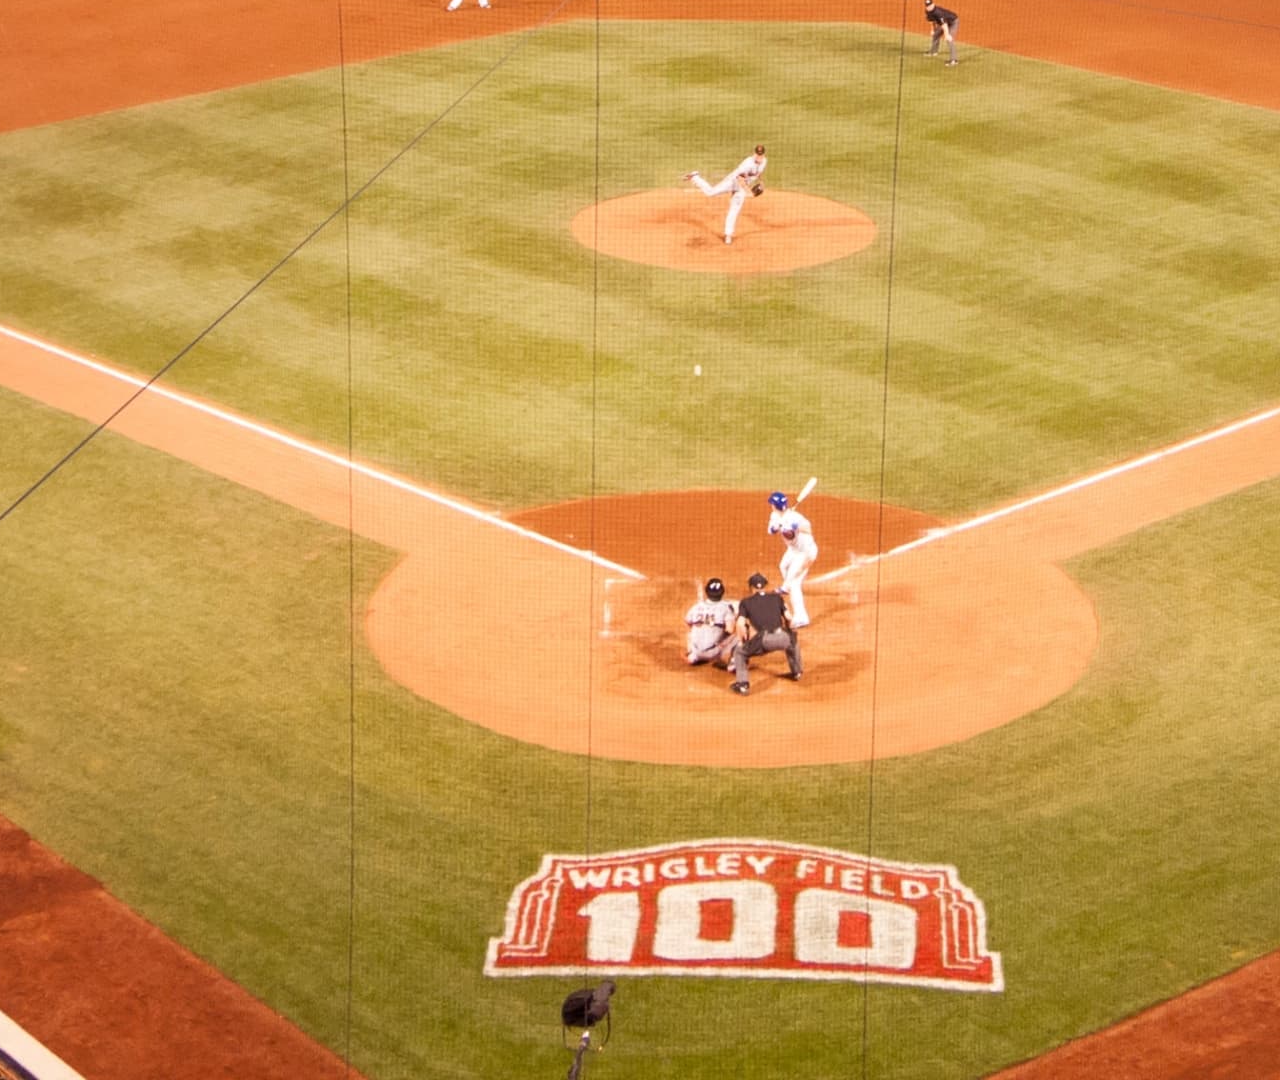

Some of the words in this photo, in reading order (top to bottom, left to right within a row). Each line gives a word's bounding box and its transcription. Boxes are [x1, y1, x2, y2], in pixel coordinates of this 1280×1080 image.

[568, 854, 776, 890] WRIGLEY
[796, 857, 930, 900] FIELD
[577, 880, 918, 970] 100
